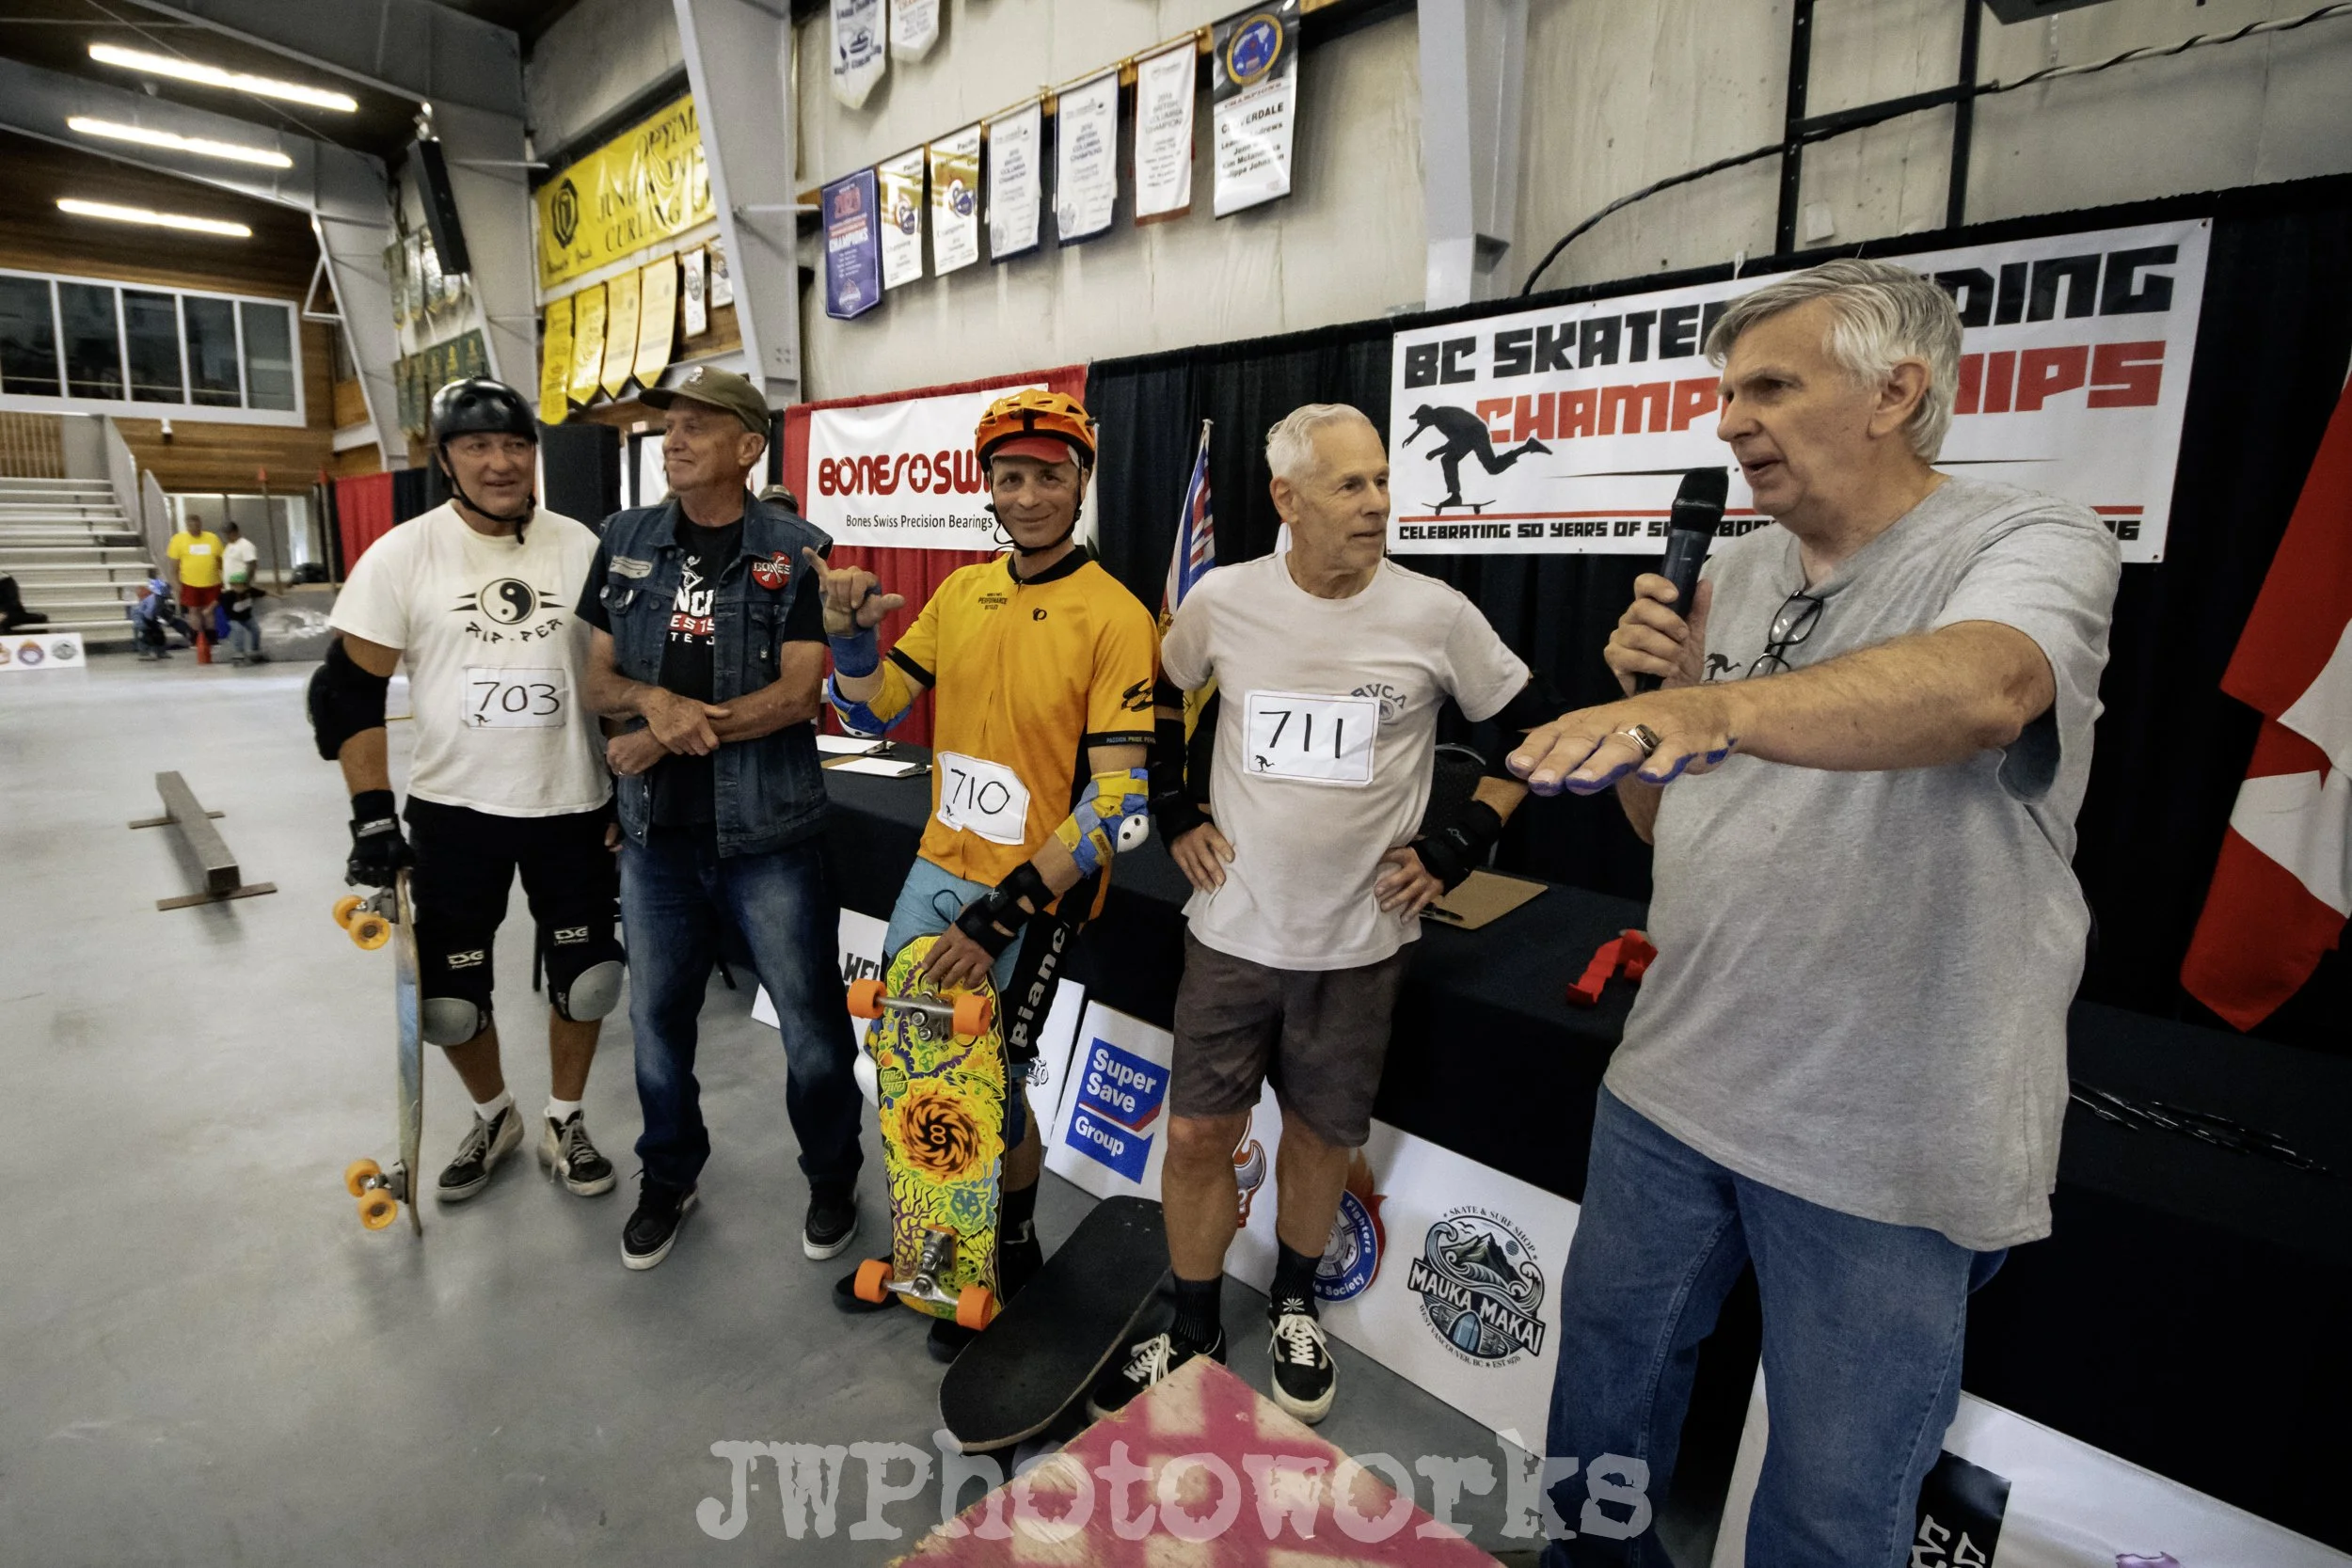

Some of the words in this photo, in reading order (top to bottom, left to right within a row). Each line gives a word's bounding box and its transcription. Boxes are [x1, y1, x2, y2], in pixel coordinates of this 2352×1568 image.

[1405, 336, 1476, 389] BC
[818, 453, 910, 497] BONES
[846, 515, 871, 528] Bones
[873, 515, 898, 528] Swiss
[901, 515, 946, 528] Precision
[948, 515, 993, 530] Bearings
[1399, 522, 1511, 540] CELEBRATING
[1518, 522, 1543, 538] 50
[1550, 521, 1608, 537] YEARS
[1613, 521, 1641, 537] OF
[472, 682, 560, 715] 703
[1259, 710, 1343, 759] 711
[950, 768, 1010, 815] 710
[1092, 1048, 1157, 1095] Super
[1086, 1077, 1136, 1113] Save
[1075, 1116, 1124, 1157] Group
[1346, 1199, 1371, 1254] Fighters
[1450, 1206, 1478, 1216] SKATE
[1480, 1208, 1487, 1216] &
[1490, 1211, 1515, 1227] SURF
[1514, 1227, 1535, 1252] SHOP
[1326, 1273, 1364, 1296] Society
[1409, 1263, 1472, 1310] MAUKA
[1479, 1298, 1544, 1352] MAKAI
[1420, 1304, 1431, 1327] WEST
